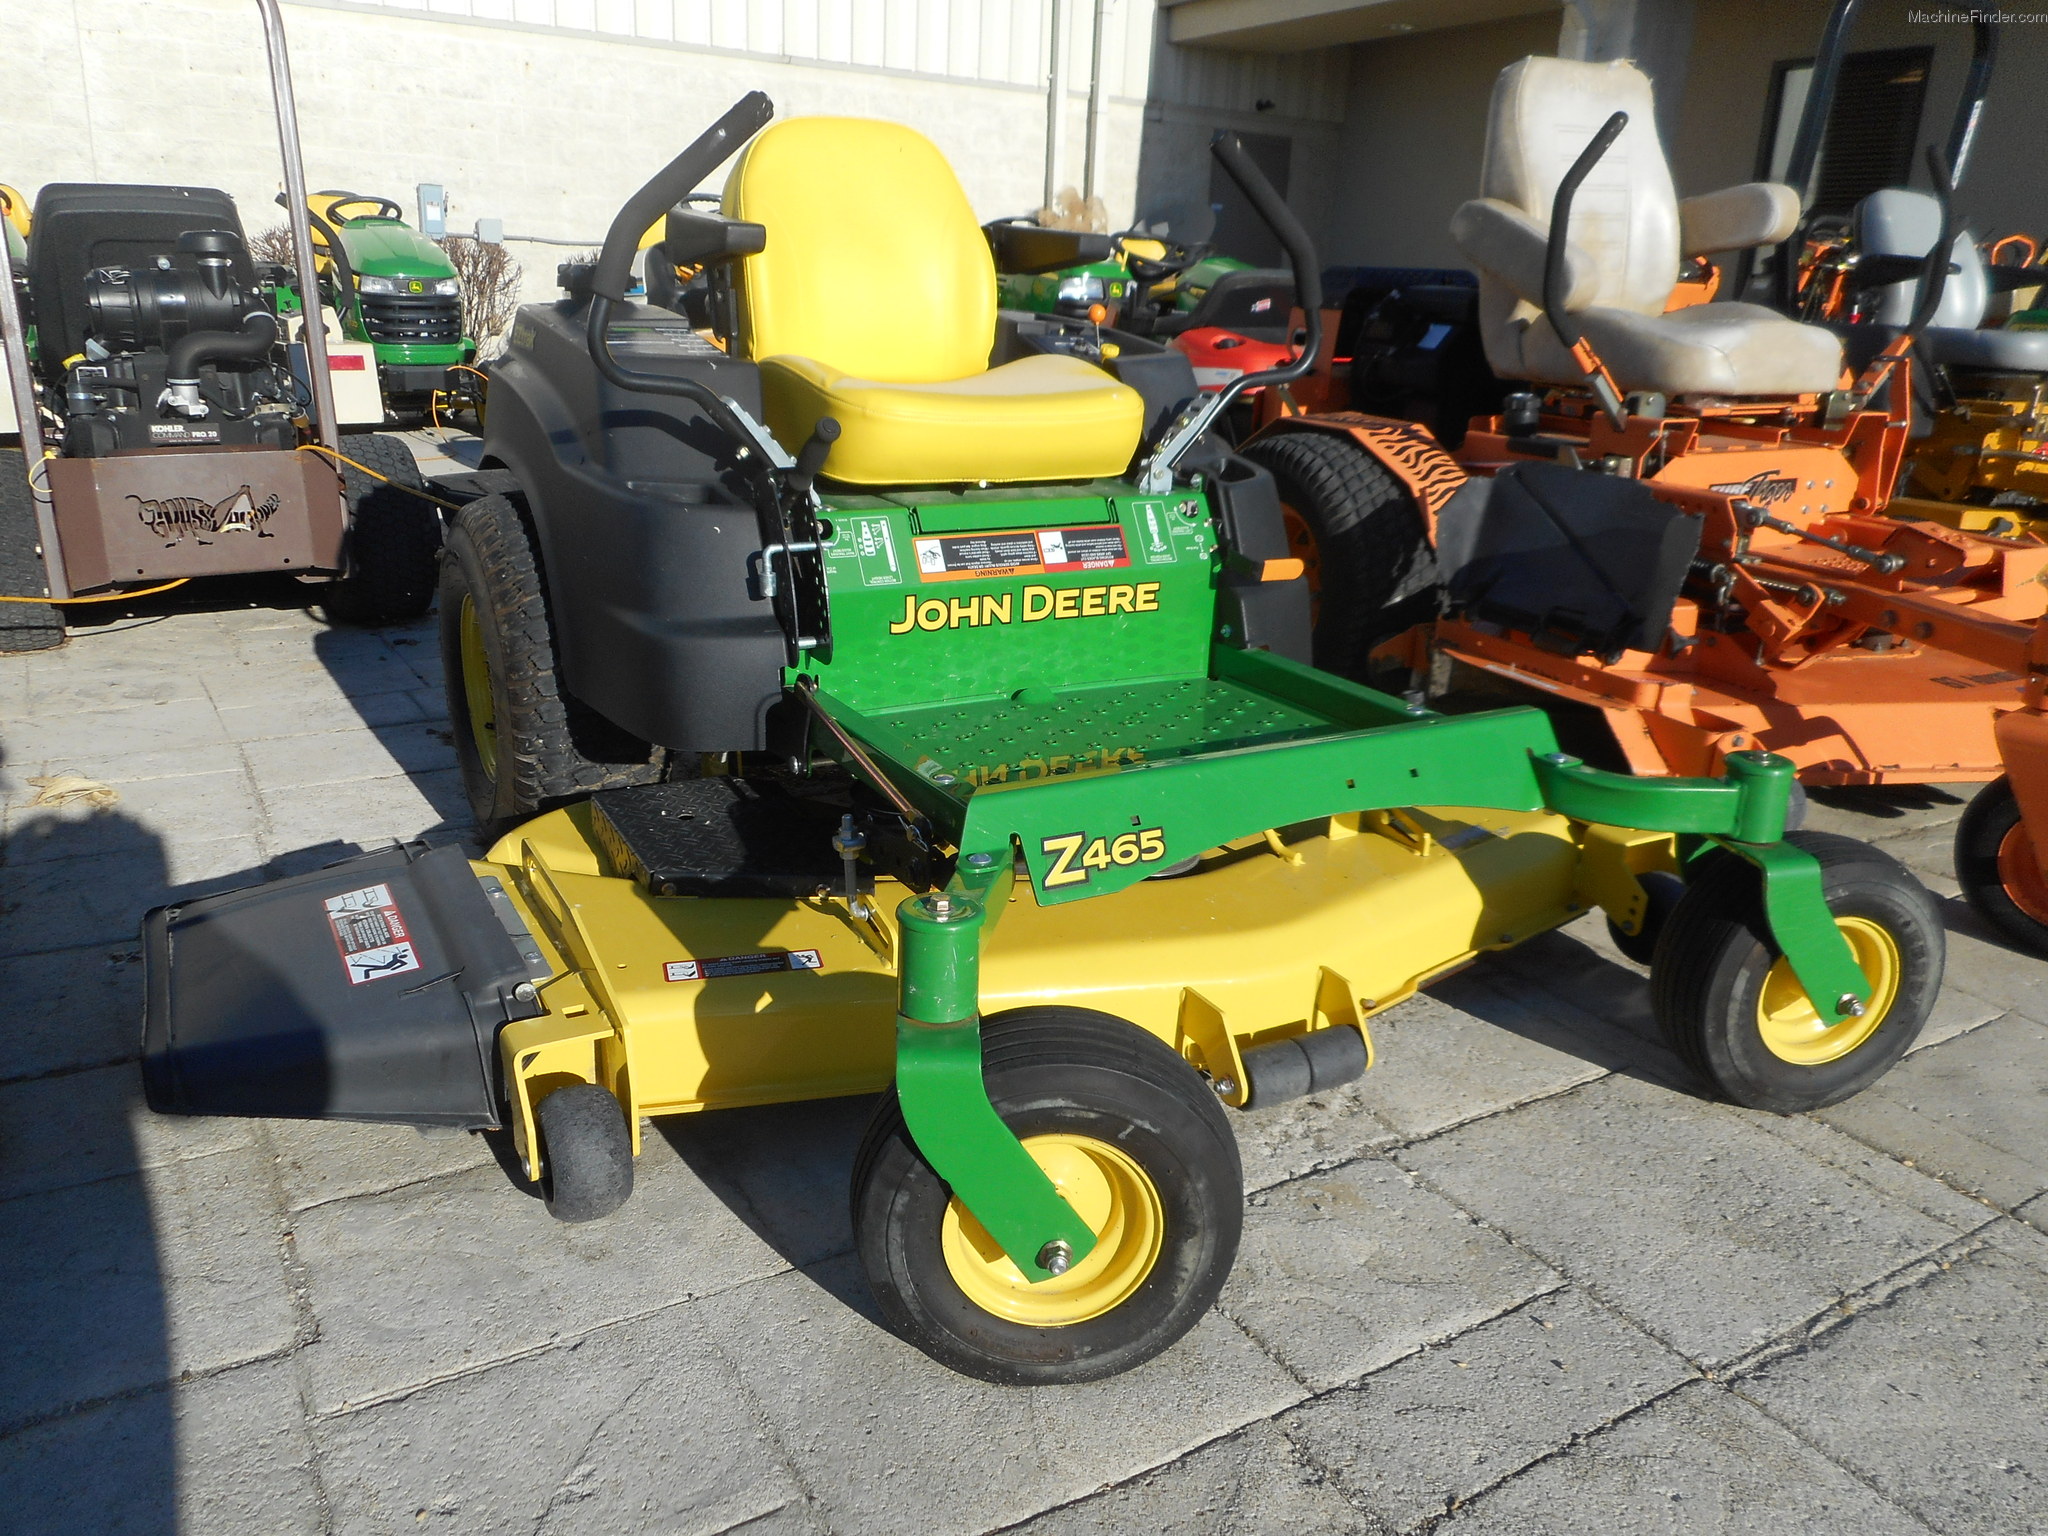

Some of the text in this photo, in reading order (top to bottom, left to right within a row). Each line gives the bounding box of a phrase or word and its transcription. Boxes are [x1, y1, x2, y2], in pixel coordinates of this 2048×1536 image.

[151, 424, 184, 433] KOHLER
[975, 568, 1009, 577] WARNING
[889, 581, 1161, 636] JOHN DEERE
[1041, 826, 1167, 891] Z465
[388, 915, 405, 938] DANGER
